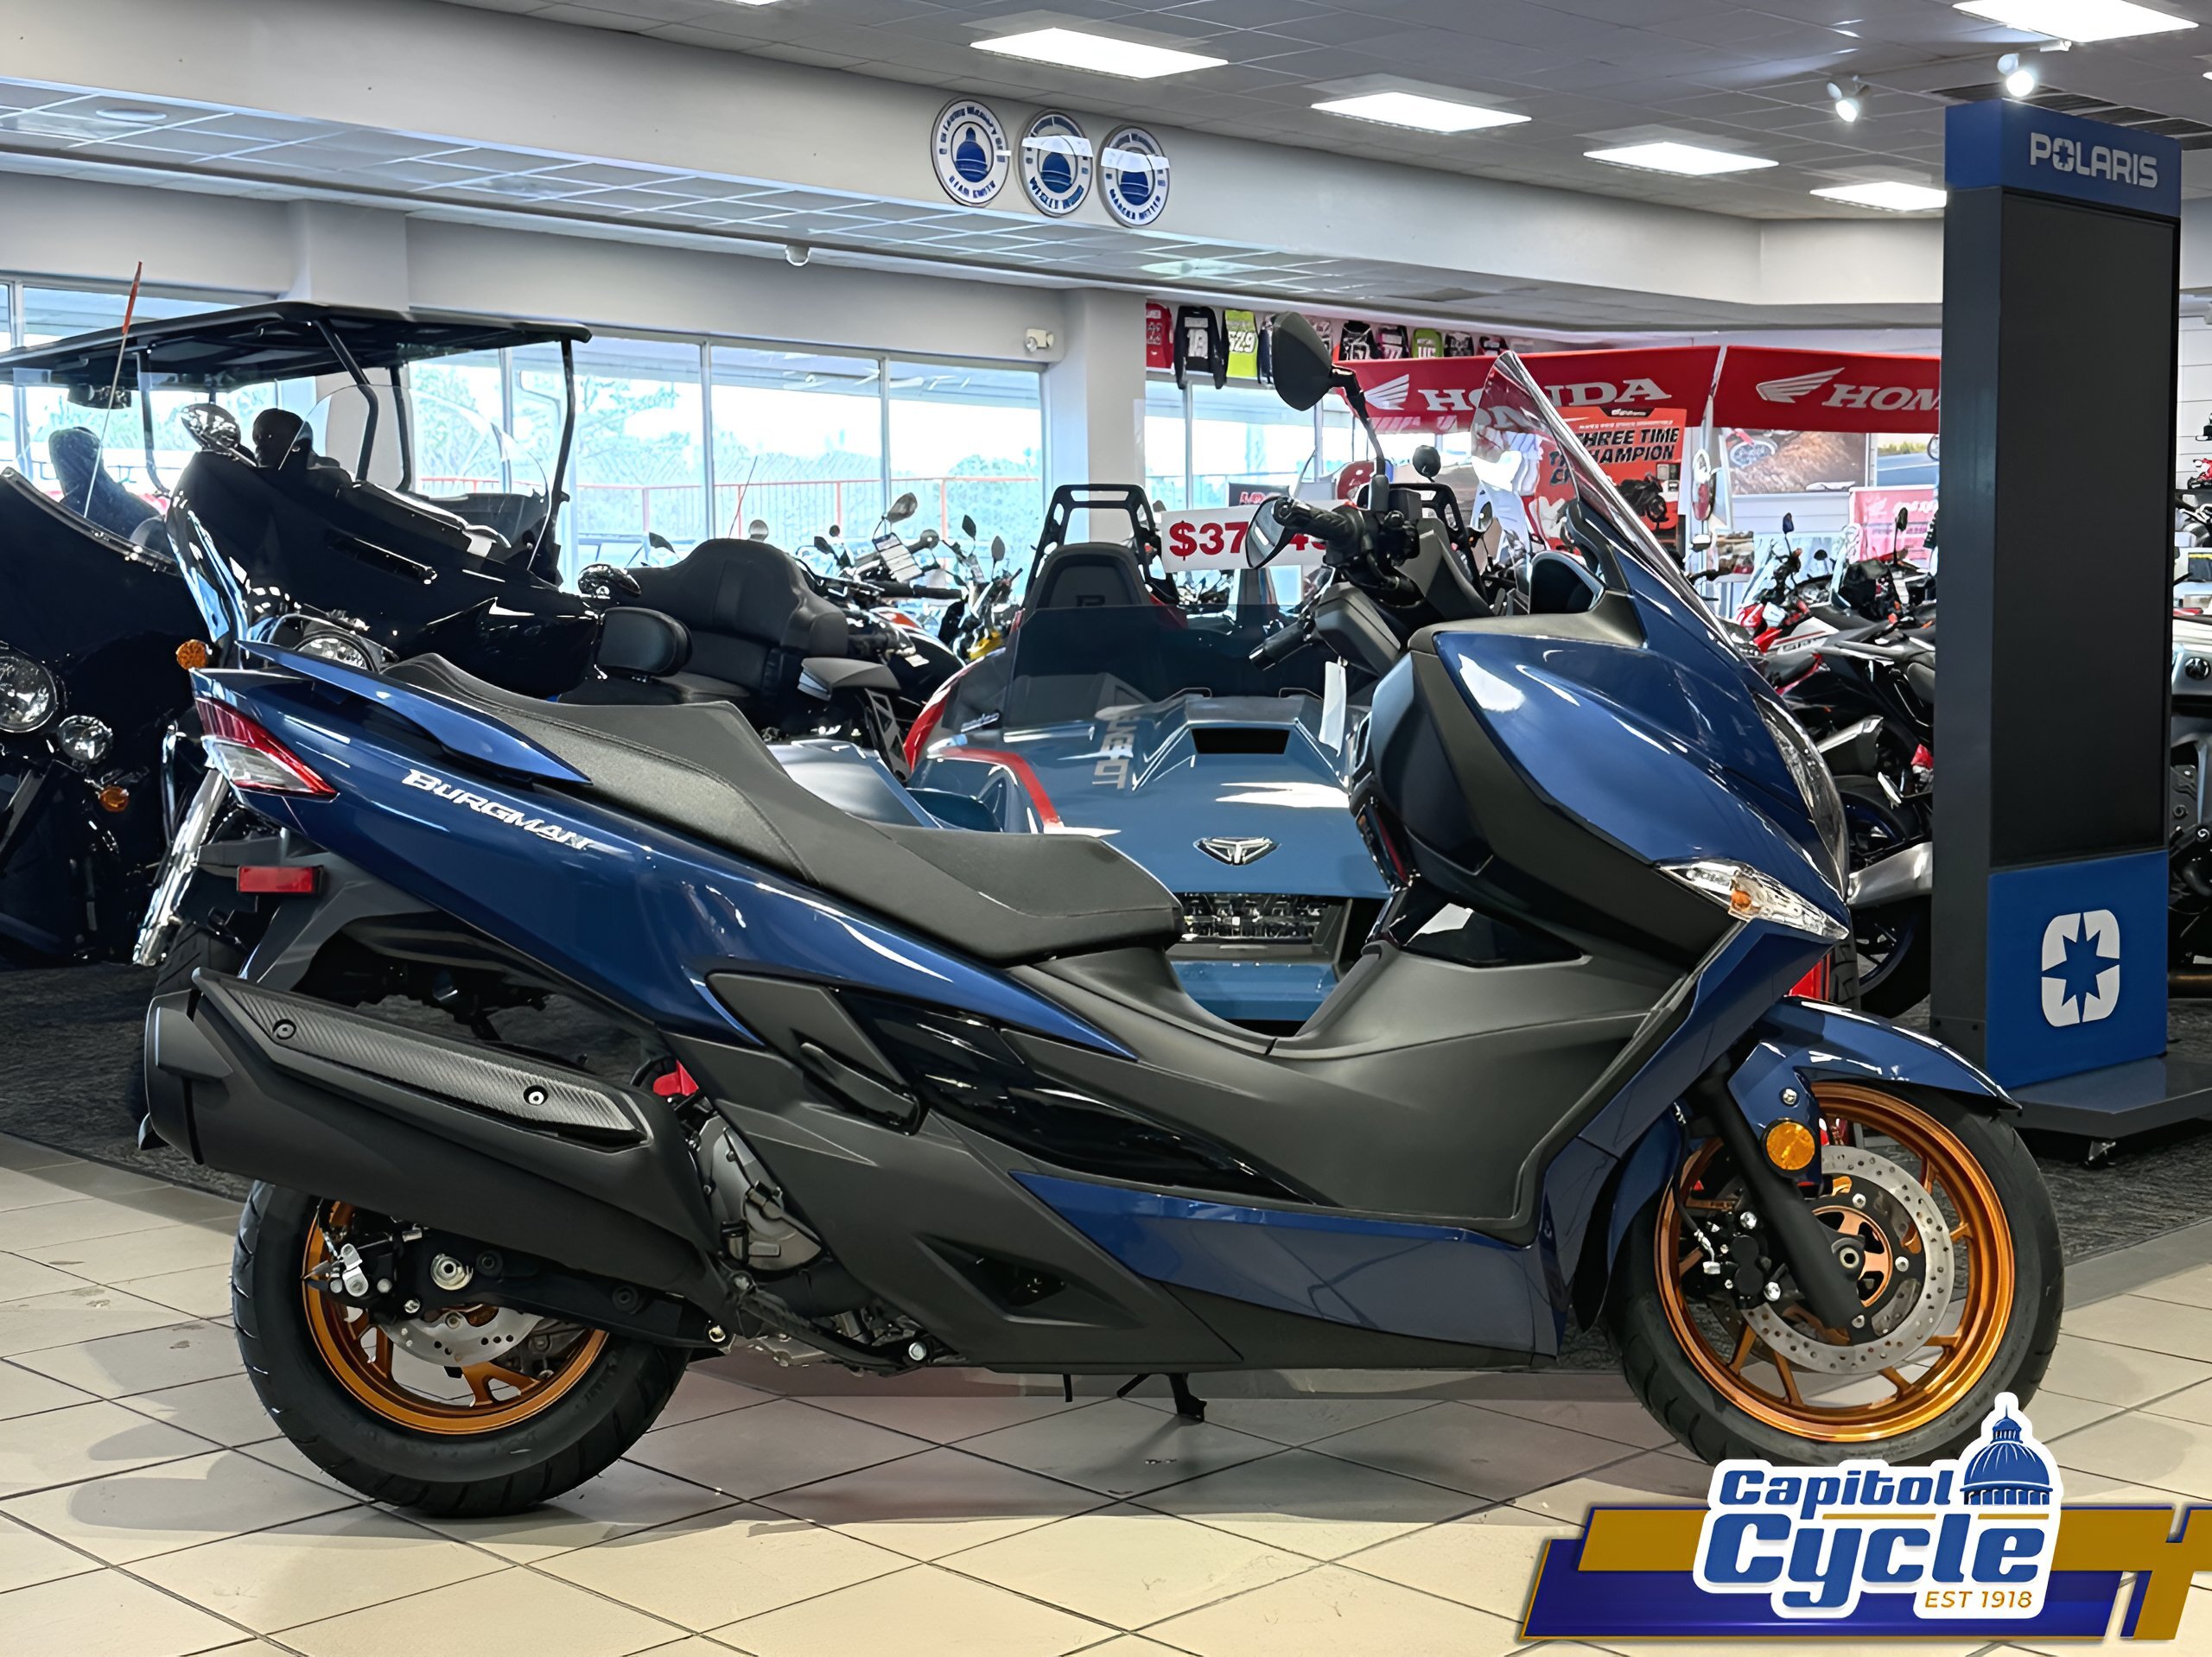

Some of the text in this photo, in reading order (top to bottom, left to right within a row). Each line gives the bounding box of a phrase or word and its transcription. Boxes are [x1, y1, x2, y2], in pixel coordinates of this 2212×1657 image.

[2031, 132, 2158, 188] POLARIS
[1821, 384, 1940, 411] HON
[1641, 428, 1680, 444] TIME
[1588, 445, 1675, 464] HAMPION
[402, 768, 594, 851] BURGMAN
